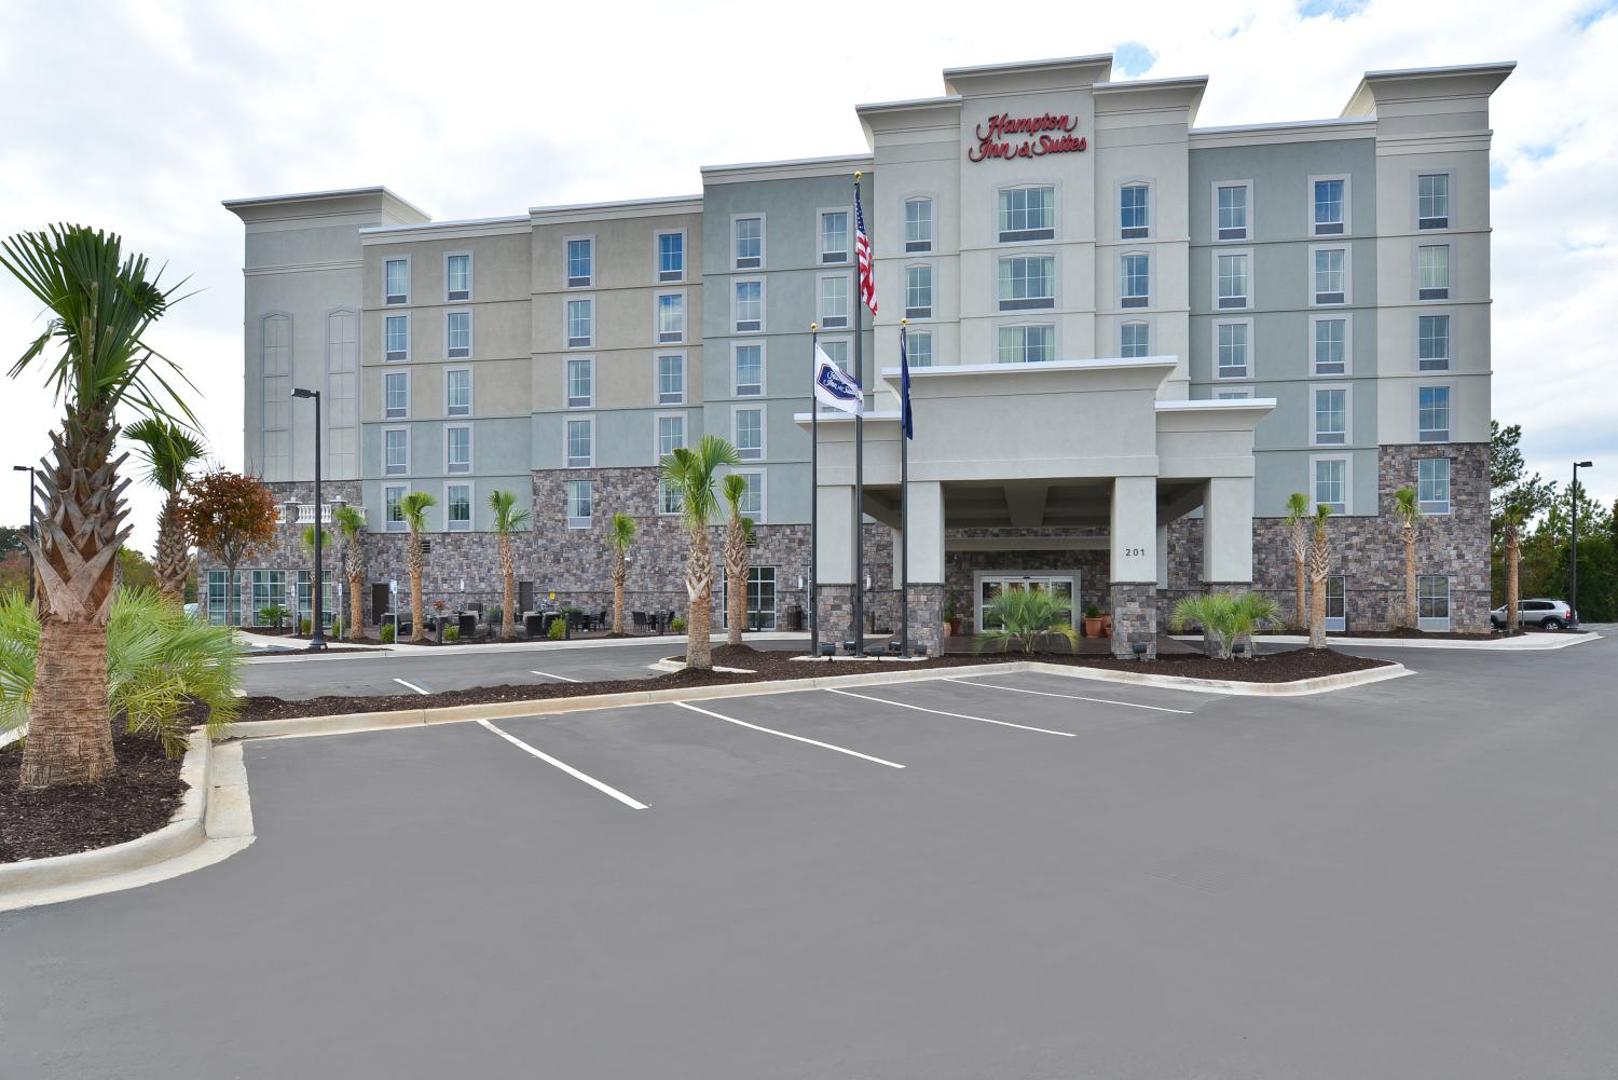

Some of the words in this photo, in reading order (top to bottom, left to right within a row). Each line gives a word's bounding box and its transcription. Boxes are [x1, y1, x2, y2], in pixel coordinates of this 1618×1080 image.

[976, 112, 1078, 141] Hampton
[968, 139, 1018, 162] Inn
[1018, 141, 1033, 159] &
[1031, 134, 1087, 156] Suites
[1125, 548, 1145, 557] 201
